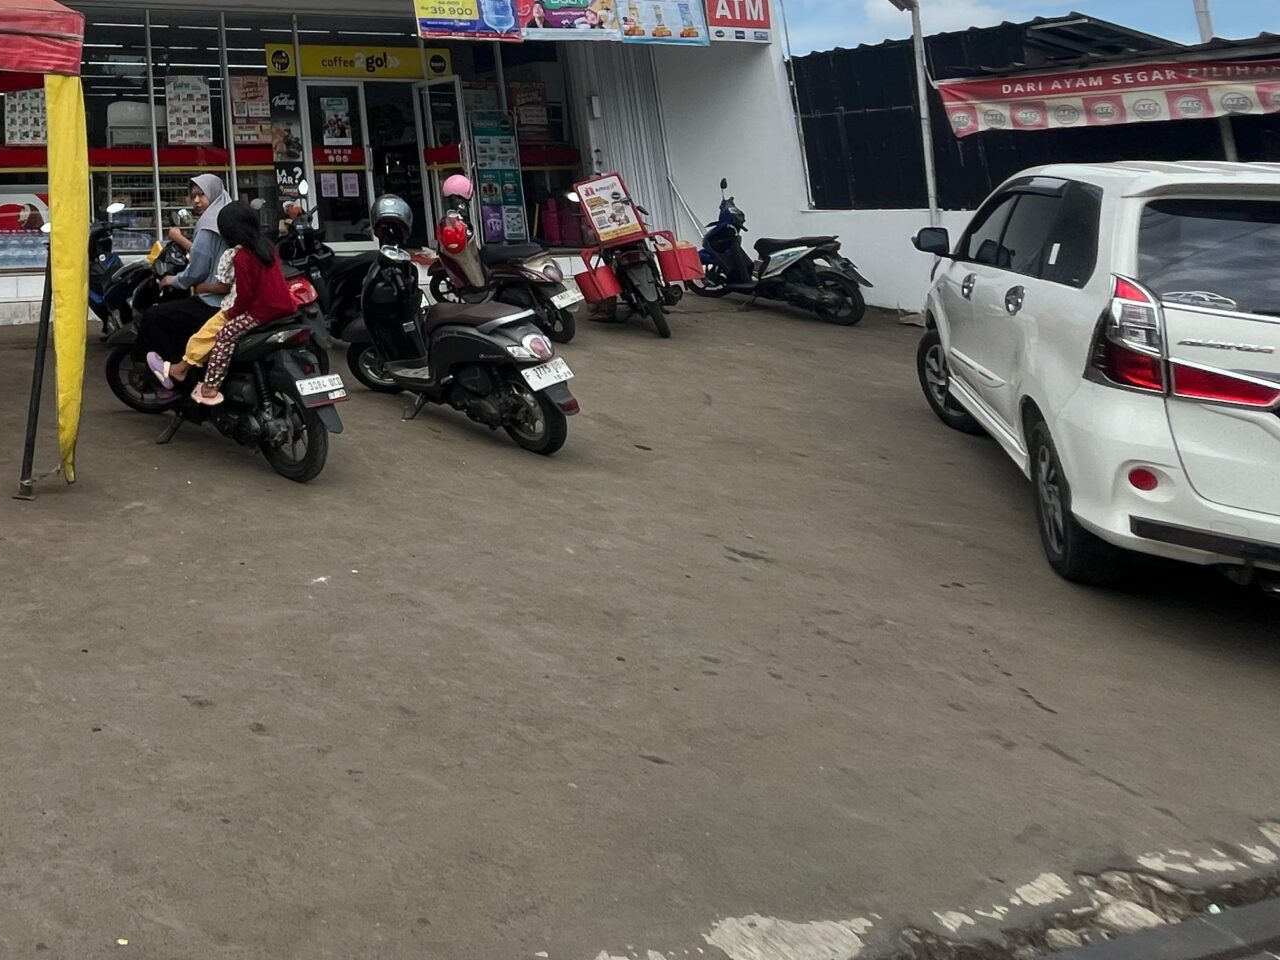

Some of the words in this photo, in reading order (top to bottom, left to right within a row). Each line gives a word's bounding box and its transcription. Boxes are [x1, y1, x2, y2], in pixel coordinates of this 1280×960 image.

[1002, 84, 1042, 94] DARI
[1051, 76, 1103, 90] AYAM
[1111, 70, 1178, 85] SEGAR
